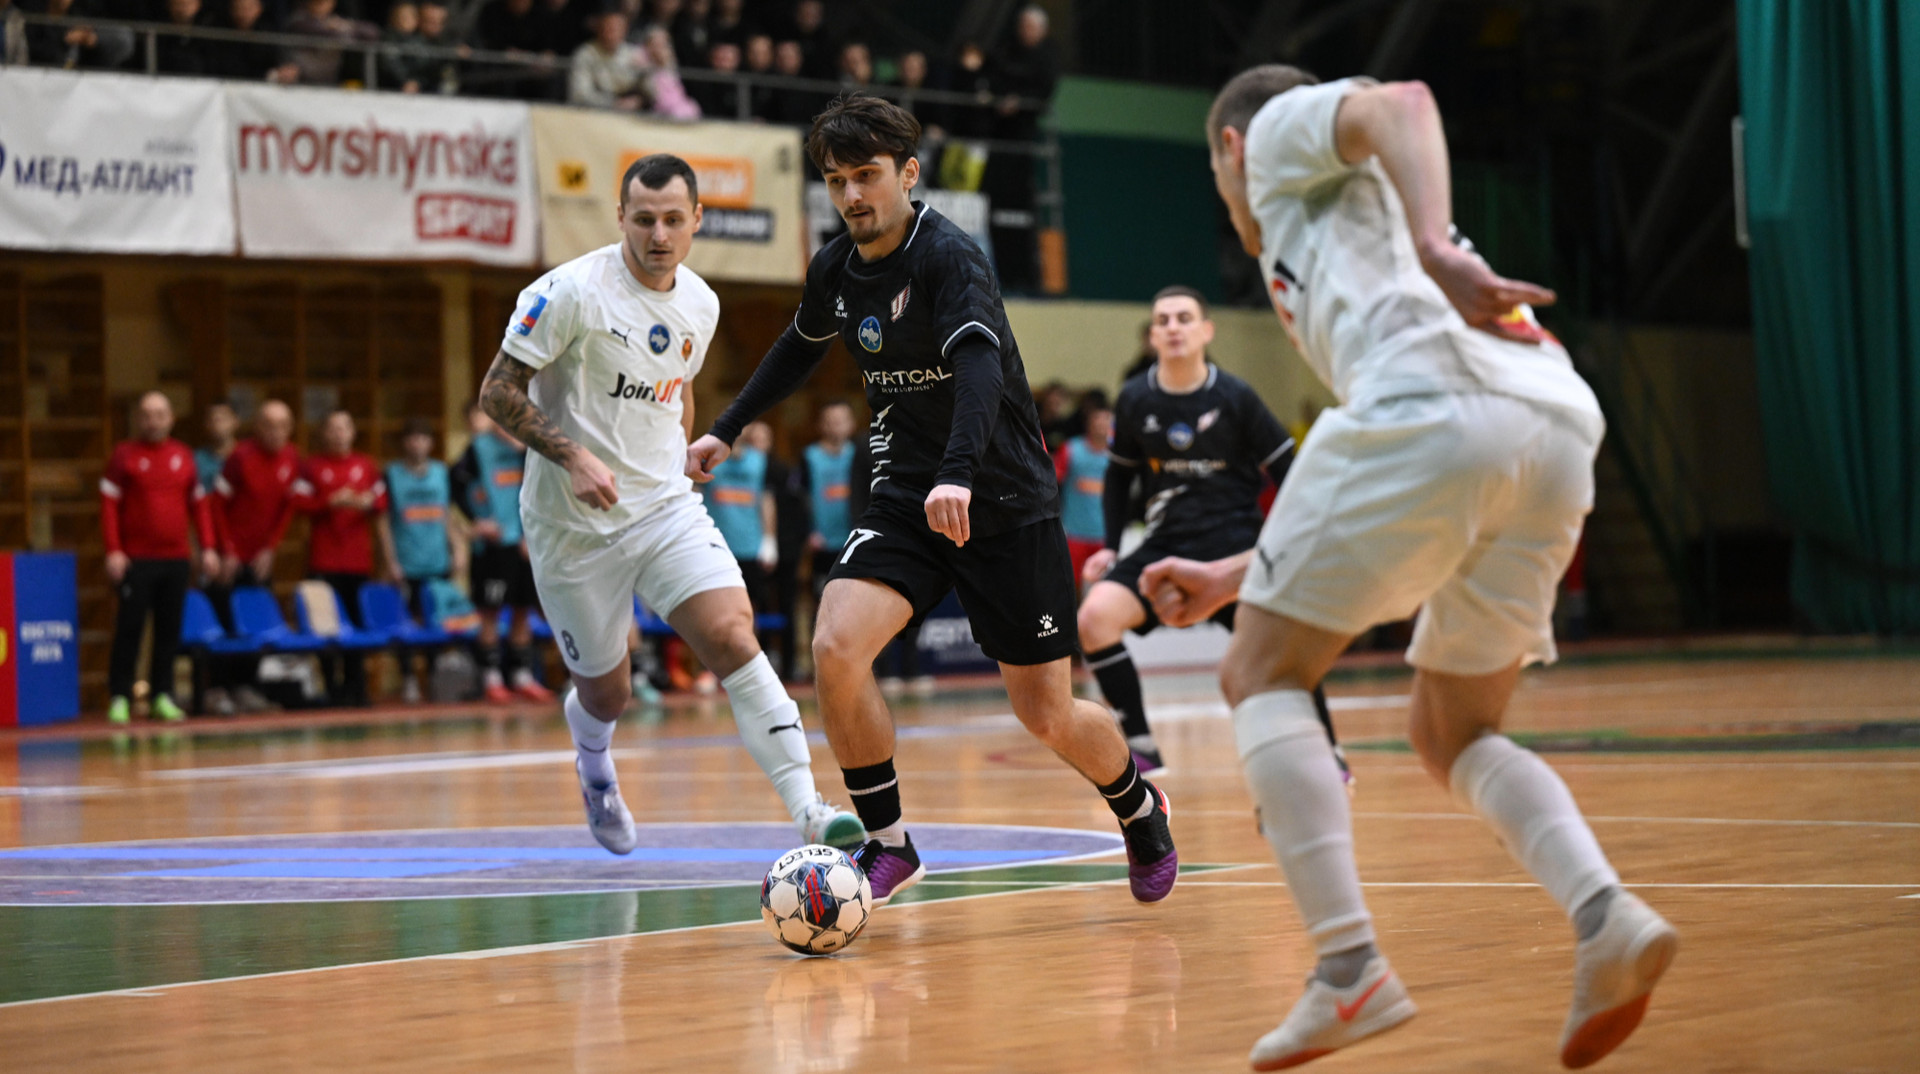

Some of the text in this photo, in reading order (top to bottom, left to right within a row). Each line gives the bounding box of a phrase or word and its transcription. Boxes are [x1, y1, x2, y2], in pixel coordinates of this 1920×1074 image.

[239, 115, 518, 191] morshynska
[14, 155, 194, 198] МЕД-АТЛАНТ
[421, 200, 512, 242] SPORT
[863, 365, 953, 386] VERTICAL
[561, 630, 580, 661] 8
[1037, 626, 1059, 638] KELME
[778, 847, 833, 872] SELECT
